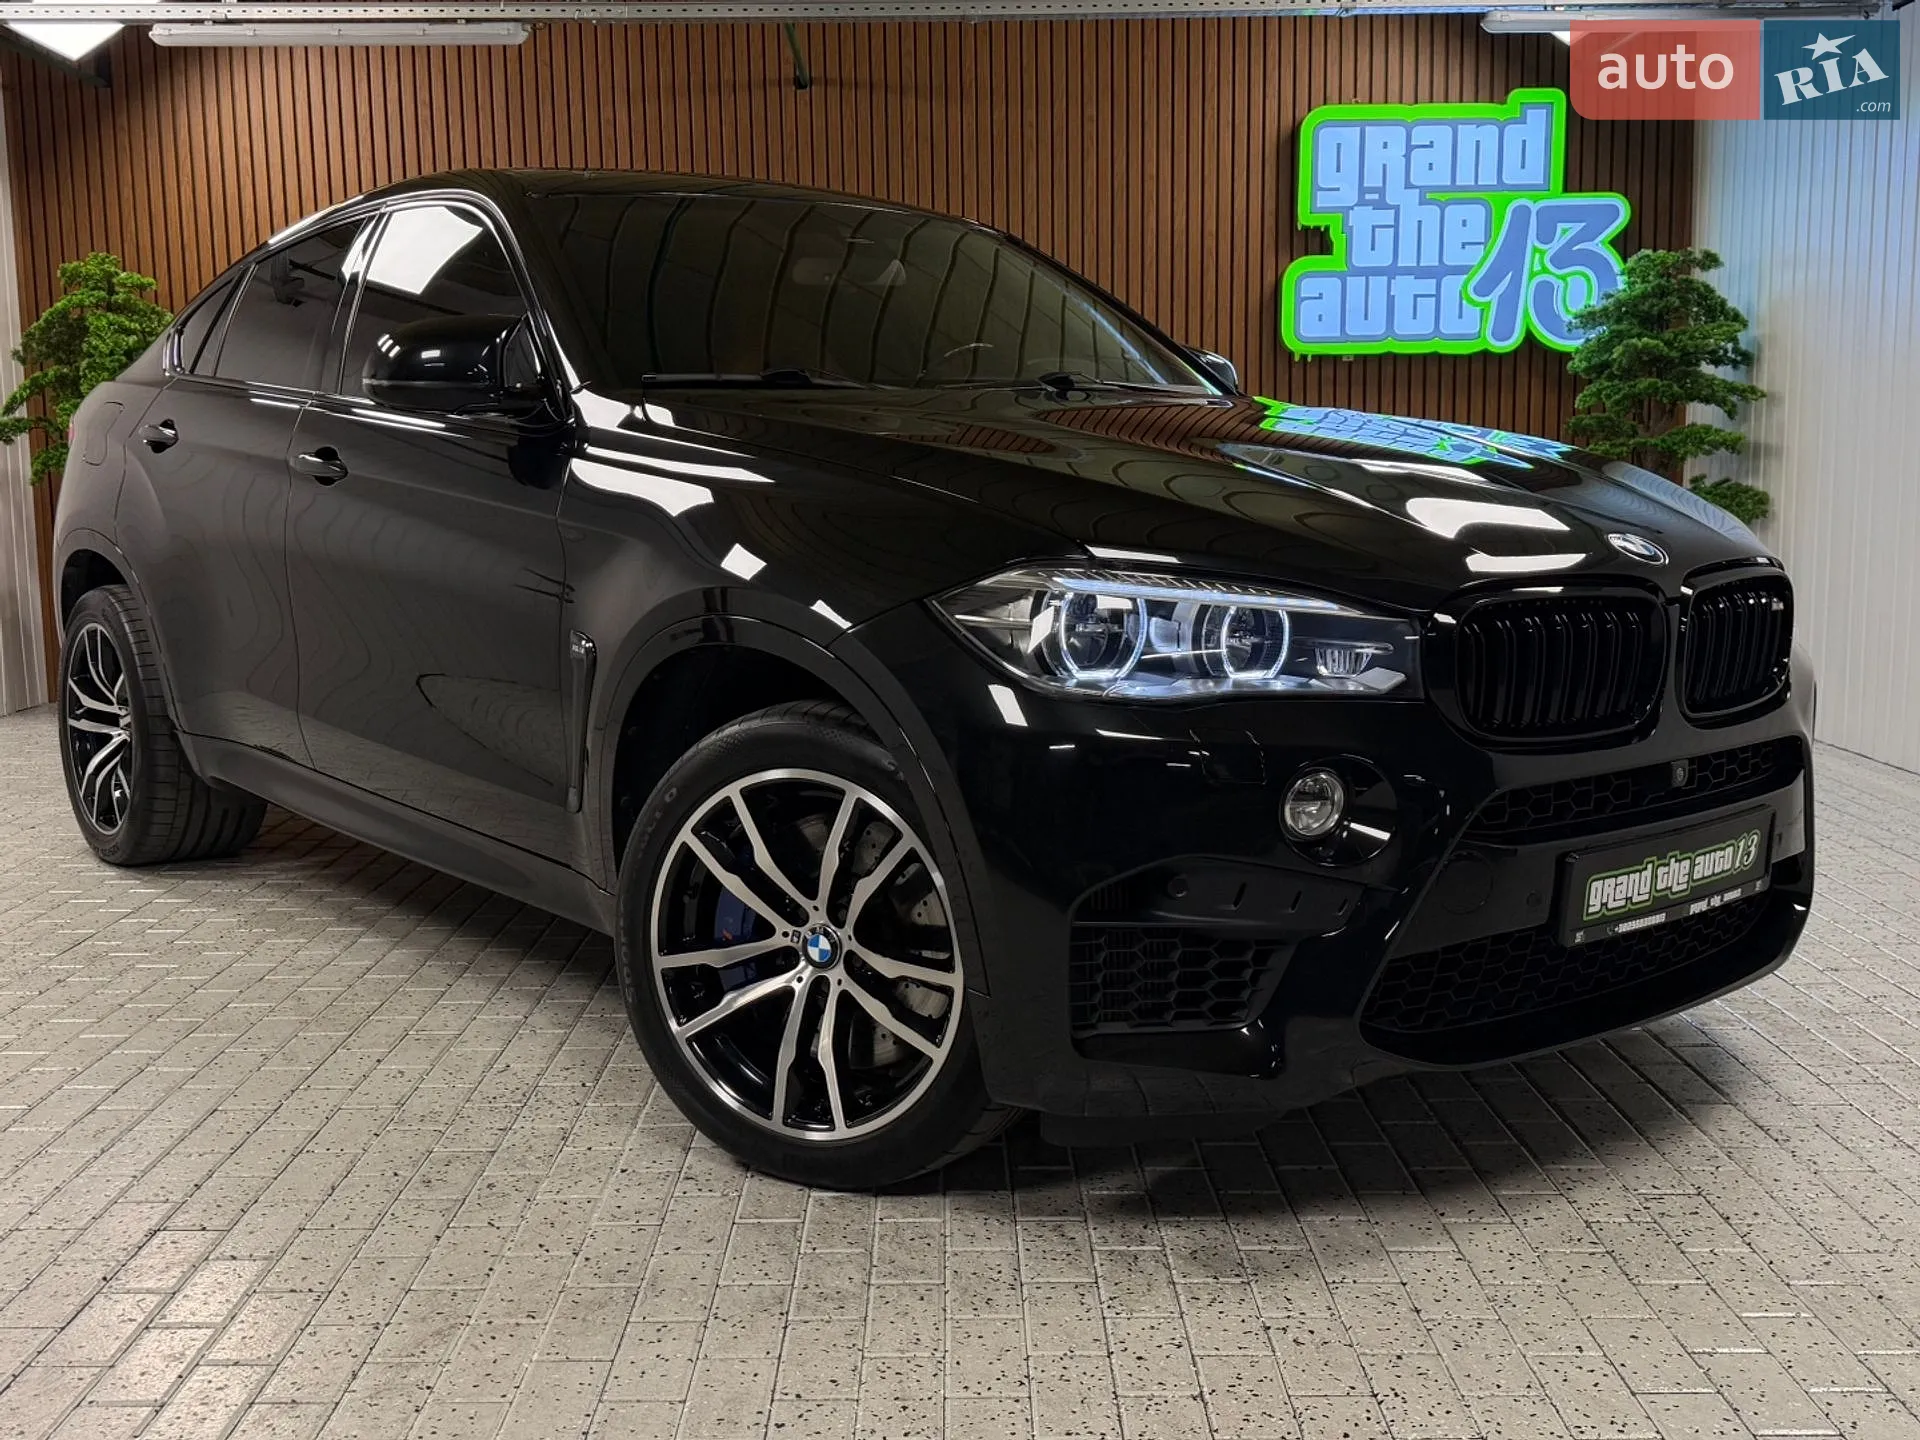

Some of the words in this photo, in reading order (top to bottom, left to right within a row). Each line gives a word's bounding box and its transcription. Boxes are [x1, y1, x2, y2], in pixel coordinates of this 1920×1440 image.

[1349, 189, 1487, 266] the
[1299, 275, 1482, 338] auto
[1469, 199, 1628, 346] 13
[1656, 858, 1691, 893] the
[1693, 846, 1734, 880] auto
[1735, 834, 1759, 868] 13
